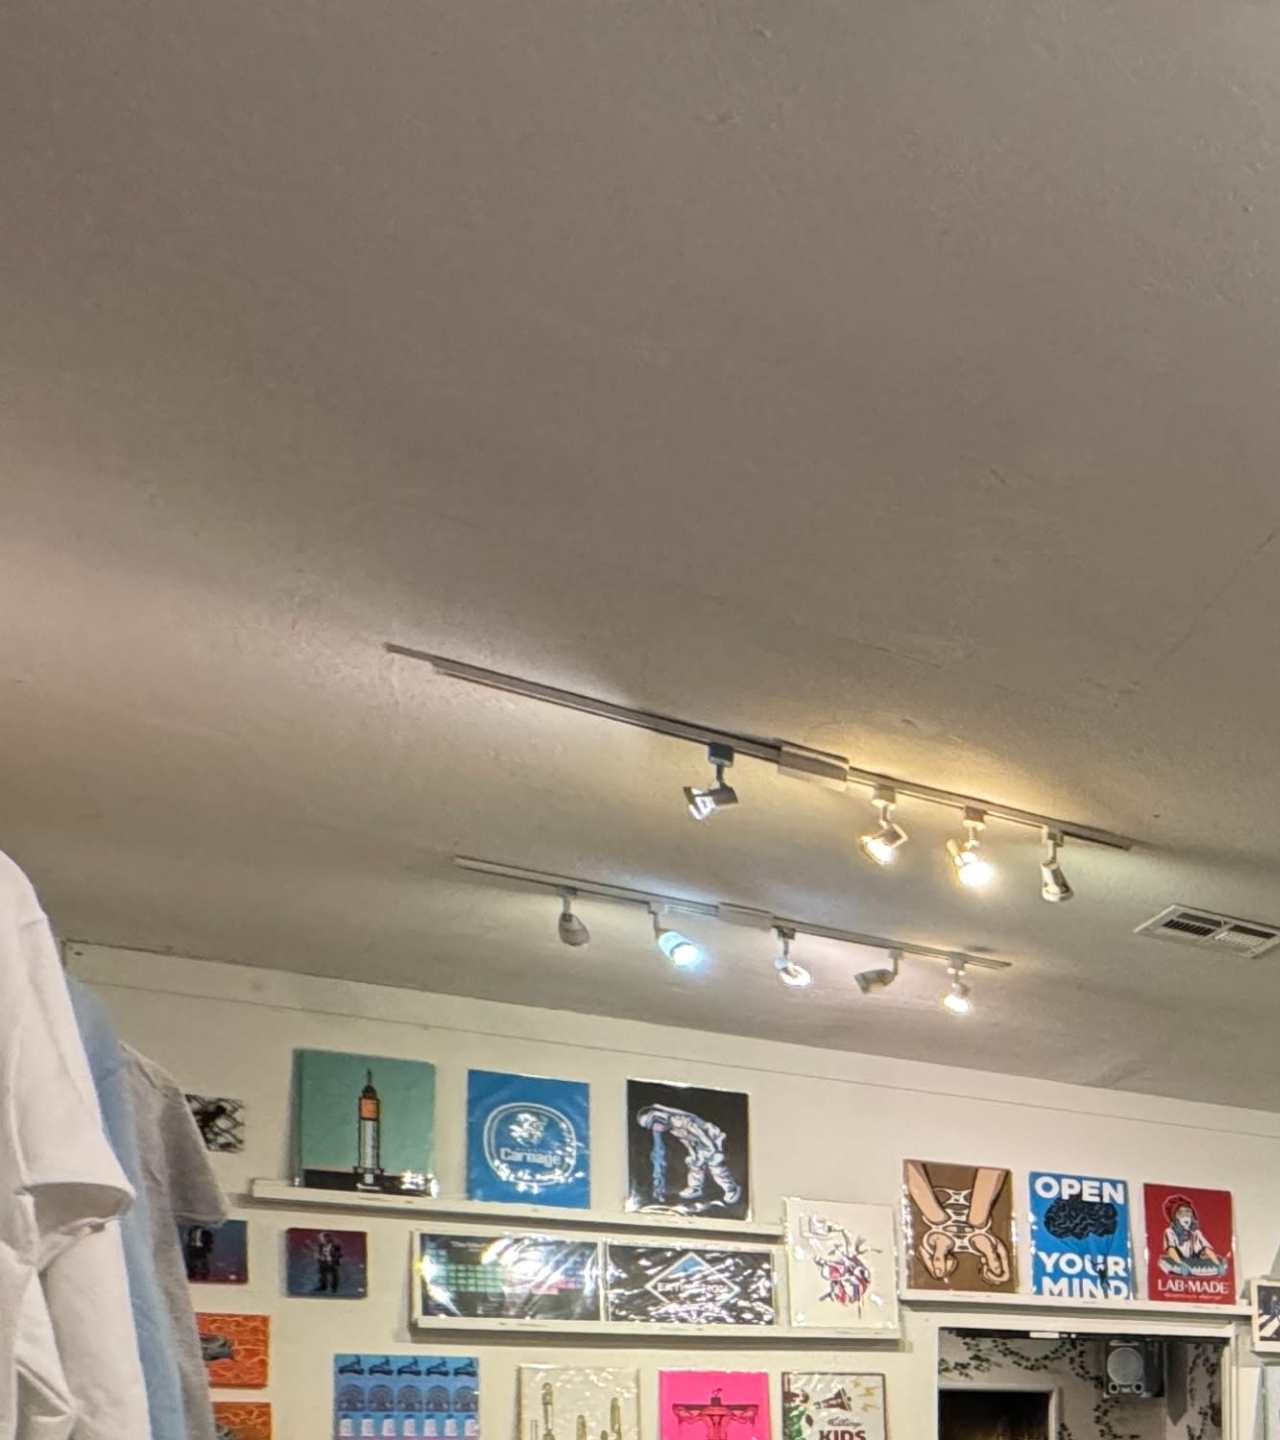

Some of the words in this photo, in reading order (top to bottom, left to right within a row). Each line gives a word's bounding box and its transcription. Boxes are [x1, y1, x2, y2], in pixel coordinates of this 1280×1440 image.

[500, 1148, 561, 1168] Carnage
[1034, 1175, 1125, 1204] OPEN
[1039, 1252, 1128, 1277] YOUR
